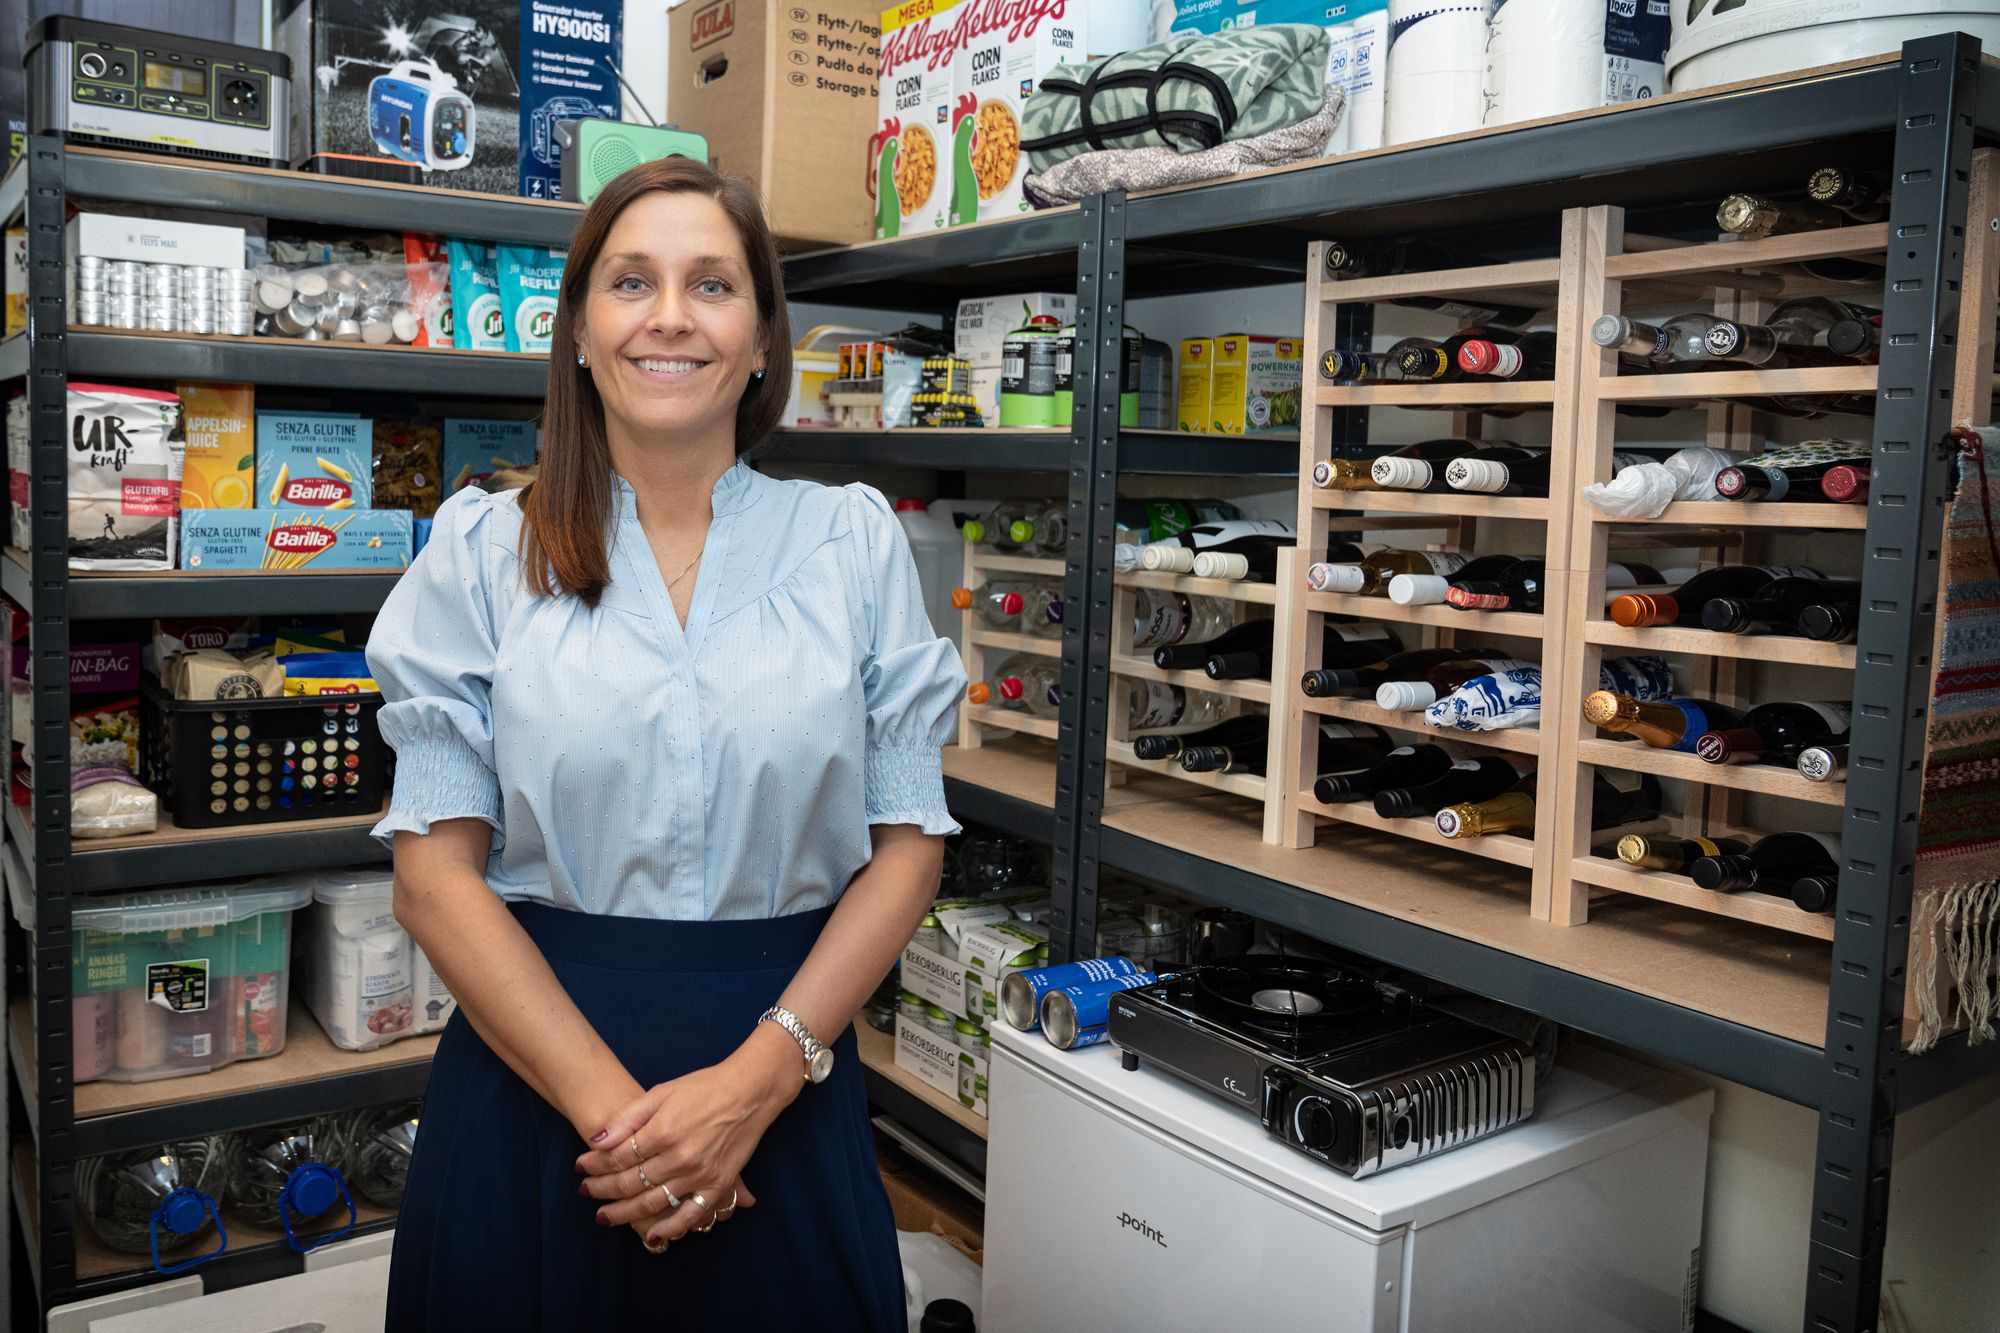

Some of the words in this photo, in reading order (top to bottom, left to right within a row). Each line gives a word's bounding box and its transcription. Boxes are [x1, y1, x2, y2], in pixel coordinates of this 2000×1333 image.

[532, 1, 573, 17] Generador
[574, 8, 604, 21] Inverter
[898, 0, 935, 23] MEGA
[533, 12, 611, 43] HY900Si
[691, 1, 733, 43] JULA
[818, 14, 881, 38] Flytt-/lag
[953, 0, 1067, 49] Kelloggs
[791, 31, 806, 42] NO
[1052, 27, 1074, 40] CORN
[1051, 38, 1074, 49] FLAKES
[972, 46, 1001, 71] CORN
[1333, 57, 1346, 70] 20
[1357, 51, 1369, 63] 24
[817, 56, 854, 73] Pudło
[857, 62, 874, 76] do
[792, 74, 805, 84] GB
[971, 67, 1000, 87] FLAKES
[816, 77, 866, 97] Storage
[896, 75, 922, 97] CORN
[895, 95, 921, 111] FLAKES
[508, 264, 521, 275] JIF
[486, 312, 504, 334] Jif
[532, 313, 555, 336] Jif
[969, 317, 983, 329] MASK
[1463, 346, 1479, 366] MARTINI
[186, 417, 247, 434] APPELSIN-
[276, 421, 310, 436] SENZA
[314, 424, 357, 437] GLUTINE
[458, 424, 486, 435] SENZA
[488, 424, 524, 436] GLUTINE
[187, 433, 220, 448] JUICE
[291, 445, 313, 454] PENNE
[315, 445, 341, 455] RIGATE
[90, 448, 127, 472] kraft
[124, 484, 169, 497] GLUTENFRI
[288, 484, 345, 500] Barilla
[189, 526, 221, 538] SENZA
[223, 527, 262, 538] GLUTINE
[273, 531, 328, 547] Barilla
[204, 545, 247, 555] SPAGHETTI
[190, 633, 223, 648] TORO
[218, 676, 249, 695] COFFEE
[87, 965, 127, 980] RINGER
[905, 948, 961, 986] REKORDERLIG
[900, 1026, 955, 1068] REKORDERLIG
[1223, 1076, 1236, 1091] CE
[1116, 1211, 1168, 1248] point
